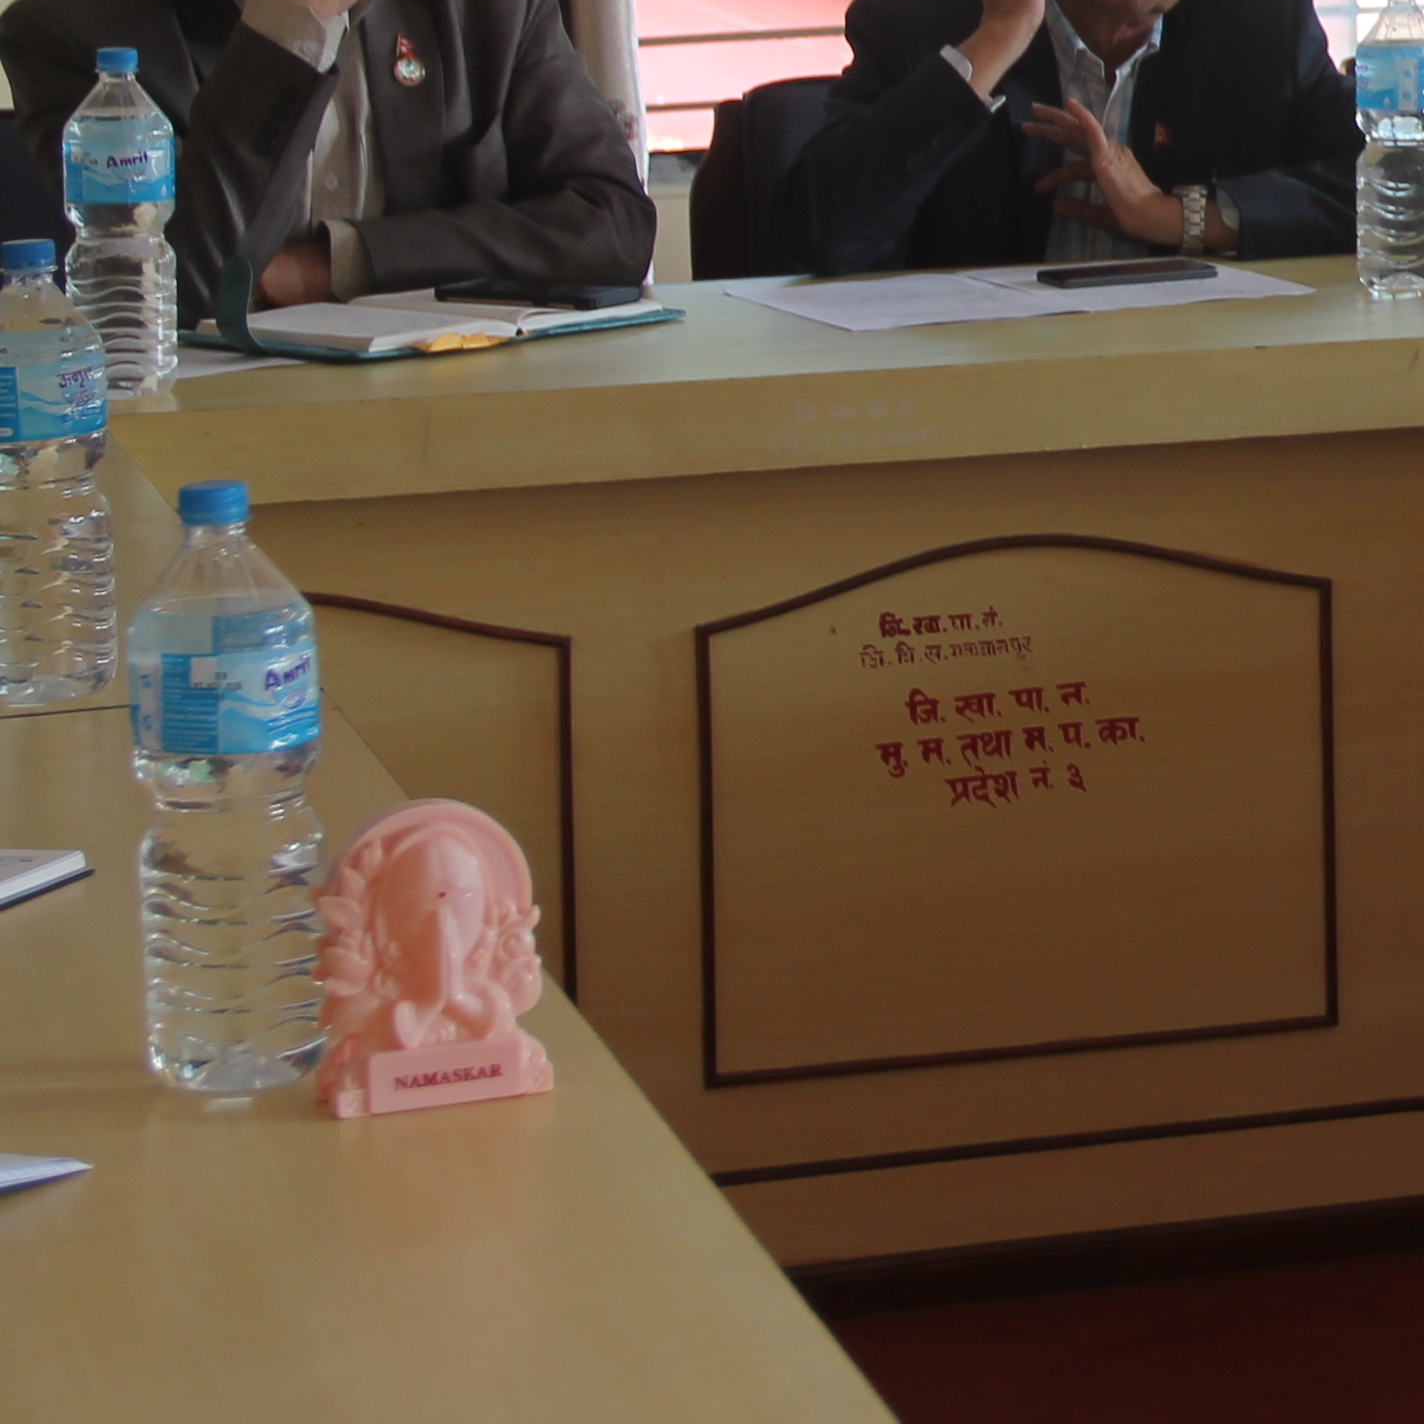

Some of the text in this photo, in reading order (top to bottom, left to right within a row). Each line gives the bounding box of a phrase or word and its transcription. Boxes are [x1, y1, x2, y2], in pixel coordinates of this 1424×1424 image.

[905, 688, 946, 725] जि.
[1008, 687, 1050, 713] पा.
[917, 738, 951, 765] म.
[956, 729, 1013, 768] तथा
[1022, 726, 1054, 753] म.
[1058, 722, 1091, 748] प.
[1094, 716, 1145, 746] का.
[944, 766, 1019, 809] प्रदेश
[1066, 763, 1088, 793] ३
[394, 1062, 503, 1090] NAMASKAR
